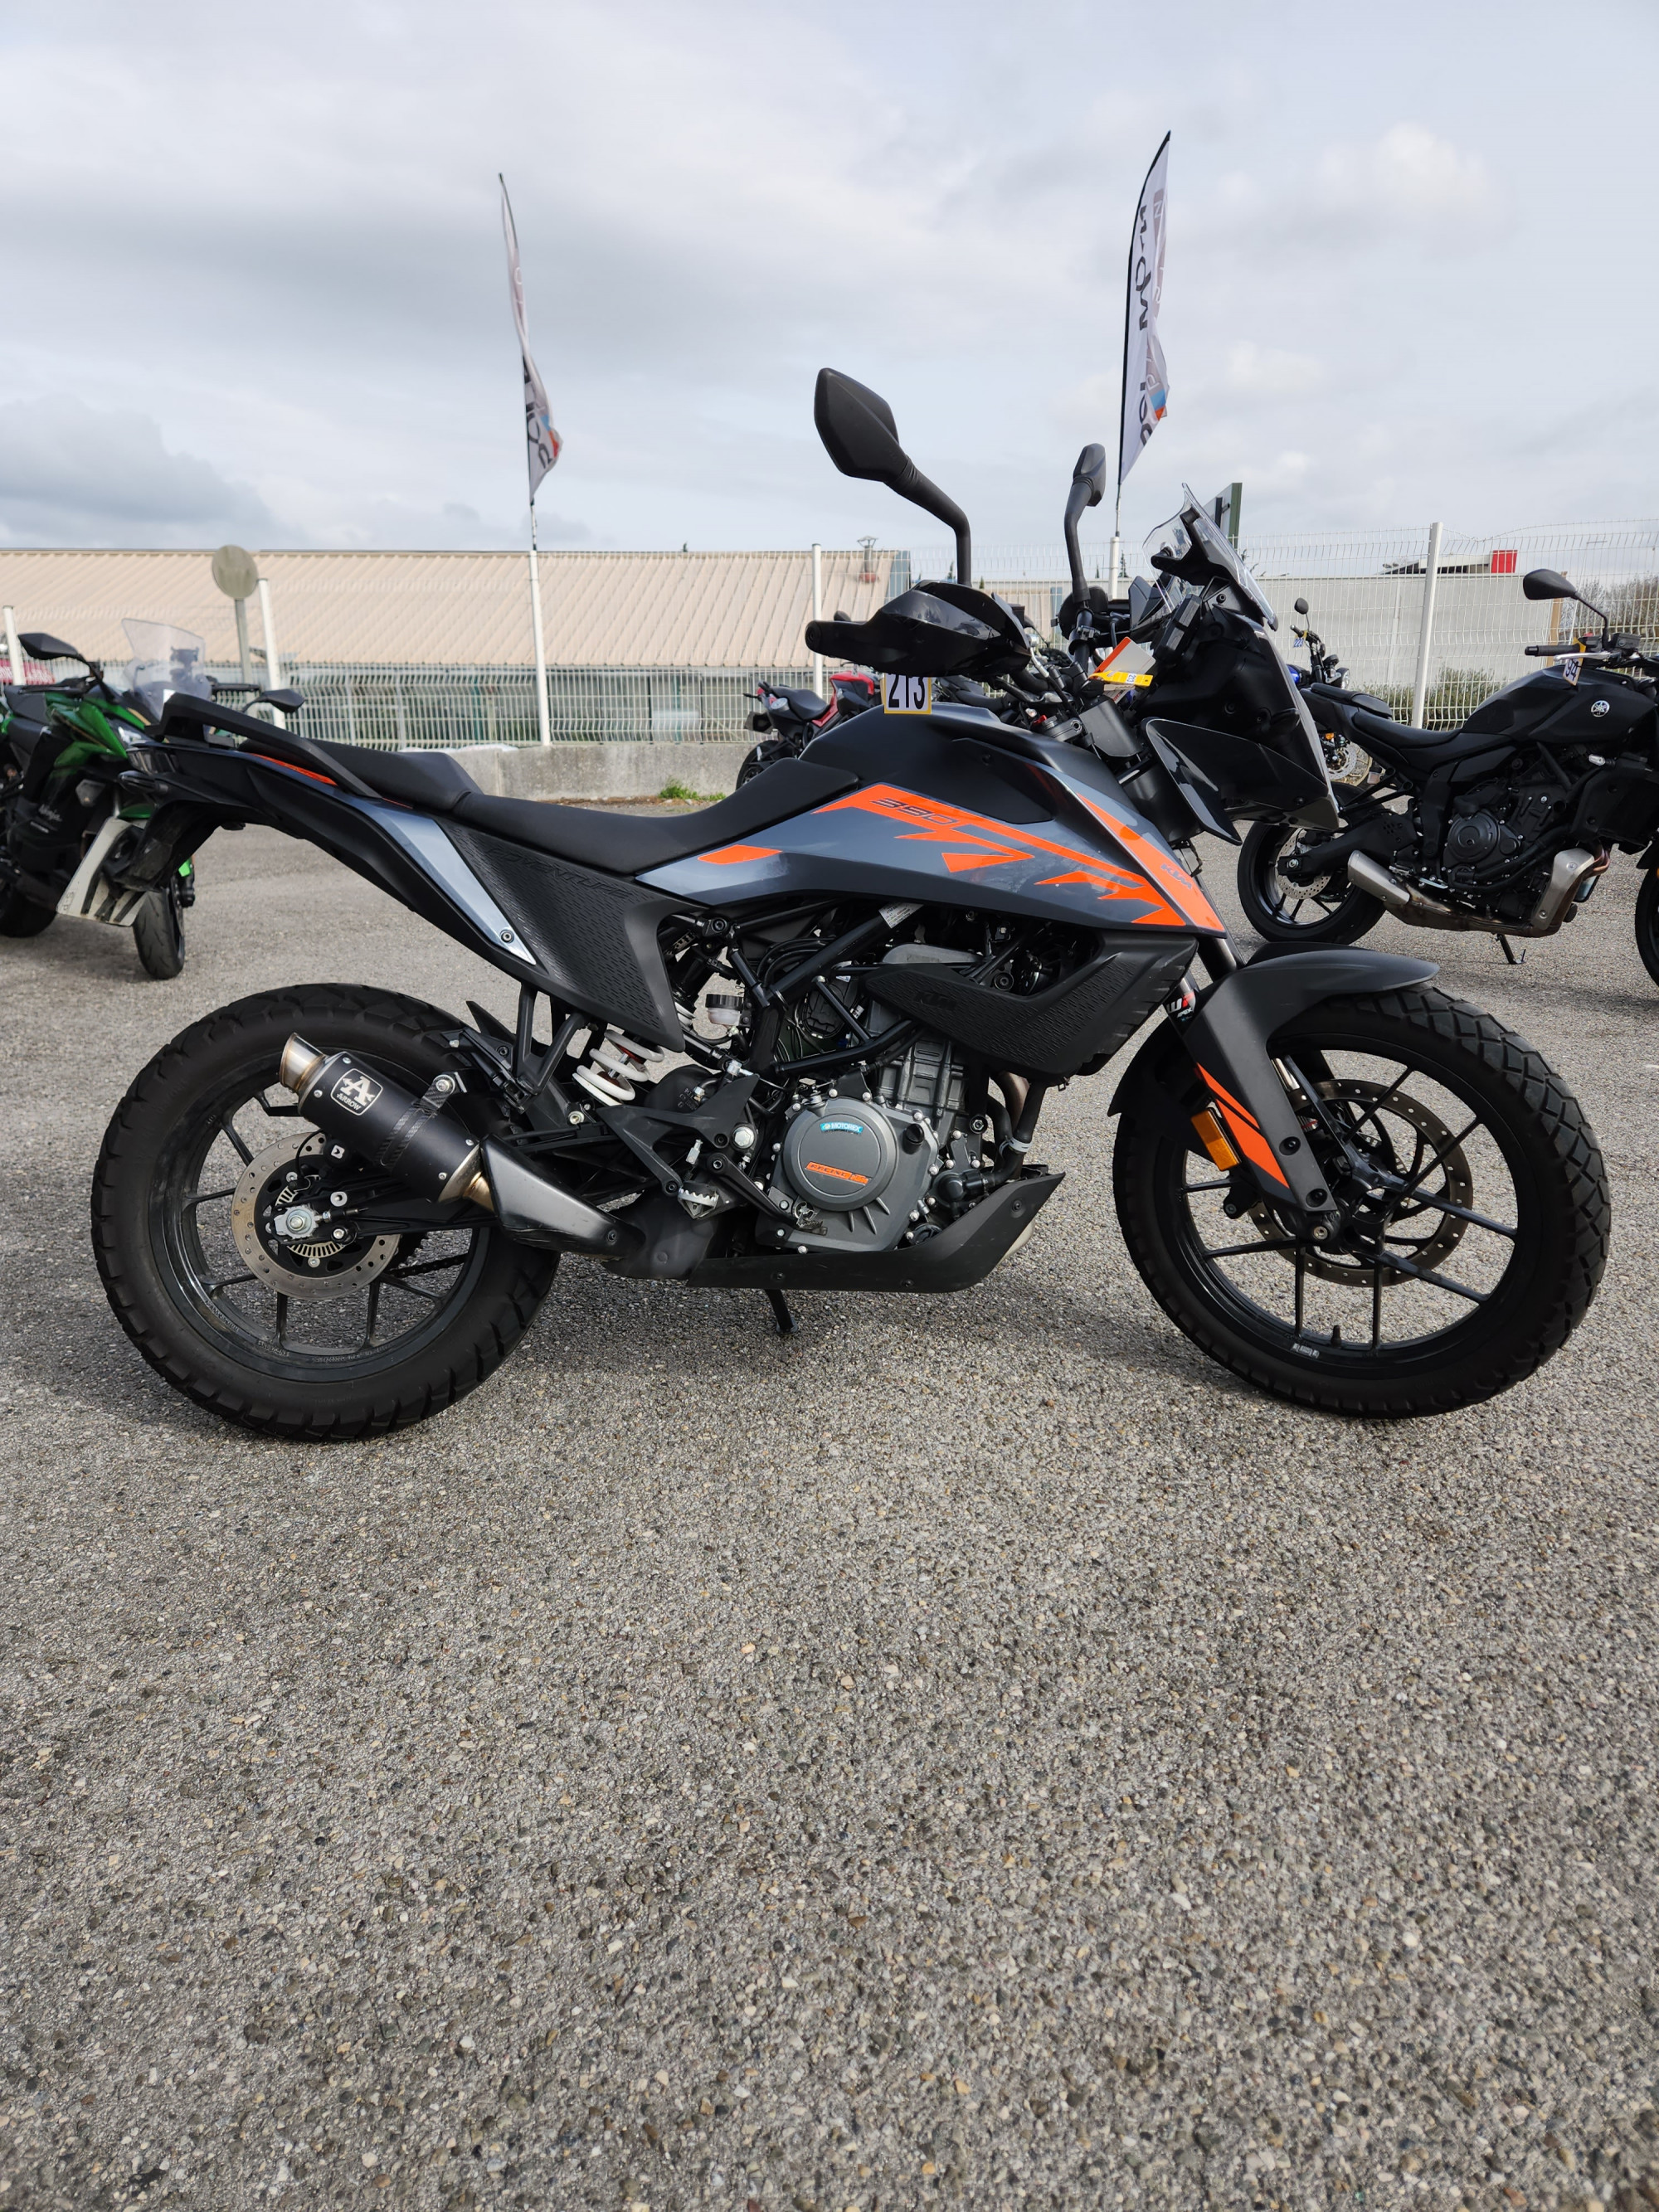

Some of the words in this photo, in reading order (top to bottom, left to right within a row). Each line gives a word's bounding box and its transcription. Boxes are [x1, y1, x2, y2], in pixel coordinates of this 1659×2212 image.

[869, 797, 961, 825] 390
[1160, 863, 1192, 889] KTM
[336, 1092, 362, 1111] ARROW
[830, 1122, 860, 1134] MOTOREX
